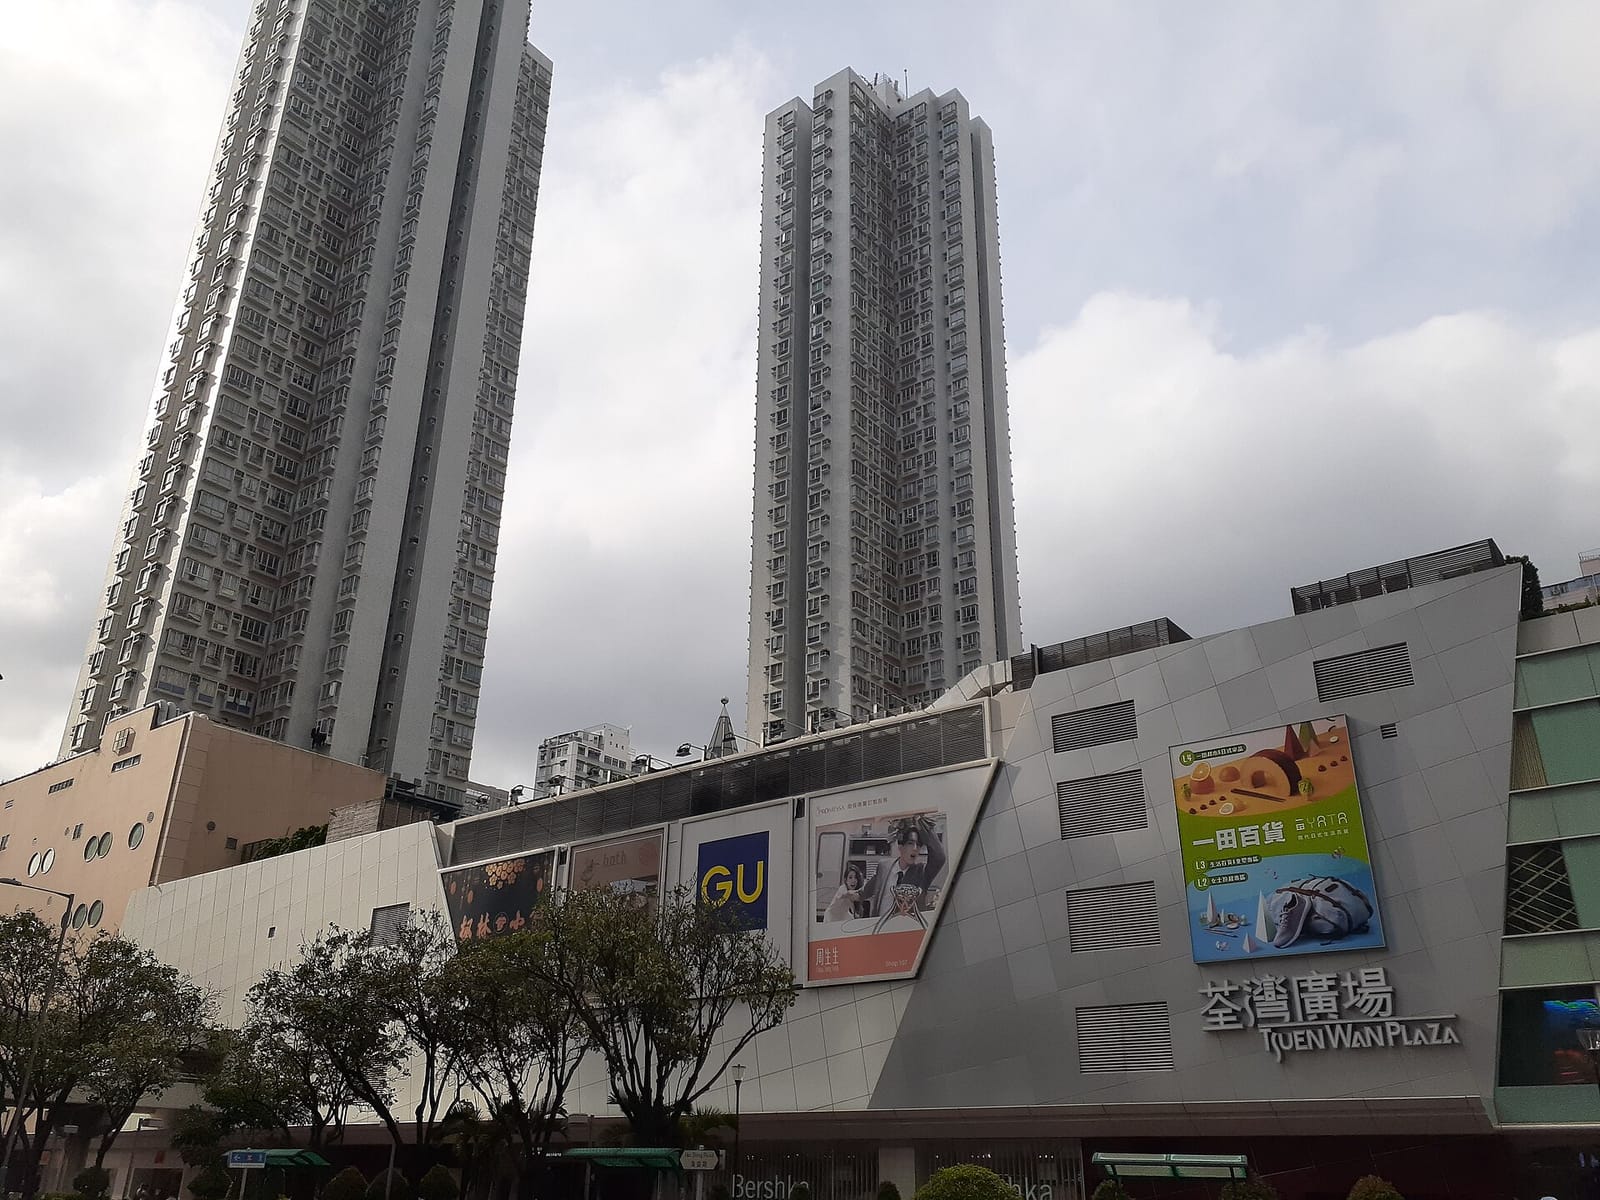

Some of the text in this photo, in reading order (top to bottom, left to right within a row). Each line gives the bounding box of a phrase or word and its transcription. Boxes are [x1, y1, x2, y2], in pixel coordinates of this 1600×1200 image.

[1192, 821, 1286, 850] 一田百貨
[701, 860, 764, 908] GU
[815, 945, 840, 966] 周生生
[1198, 967, 1394, 1031] 荃灣廣場
